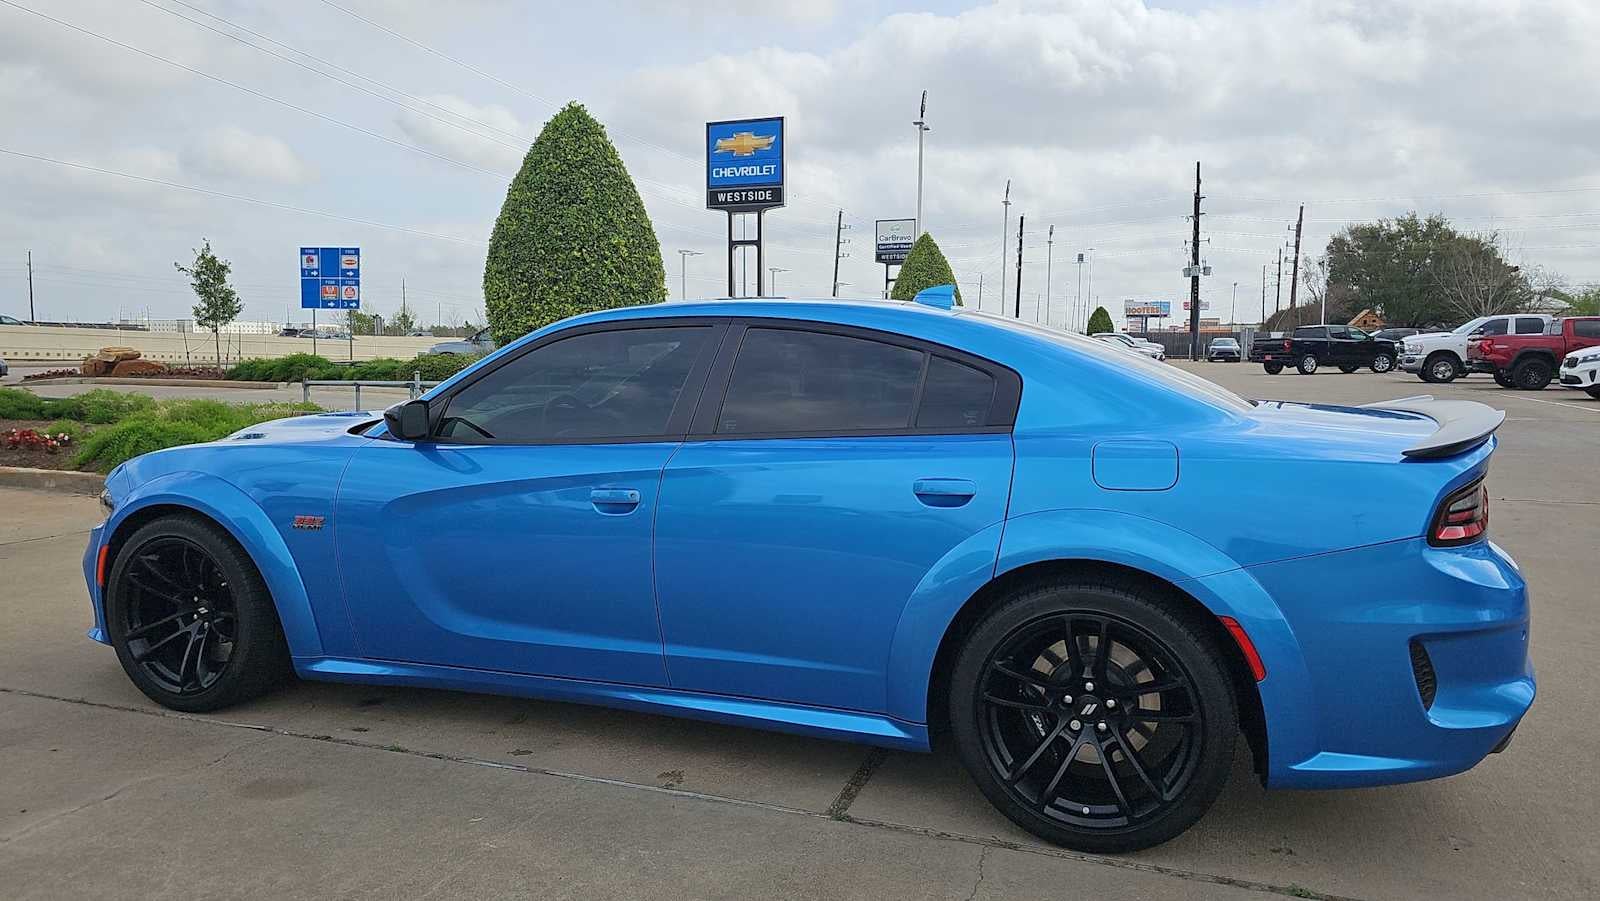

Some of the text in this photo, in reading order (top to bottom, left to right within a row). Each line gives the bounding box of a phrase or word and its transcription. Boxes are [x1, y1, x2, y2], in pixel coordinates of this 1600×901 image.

[713, 165, 777, 178] CHEVROLET
[718, 190, 772, 202] WESTSIDE
[879, 234, 912, 242] CarBravo
[1125, 306, 1160, 314] HOOTERS
